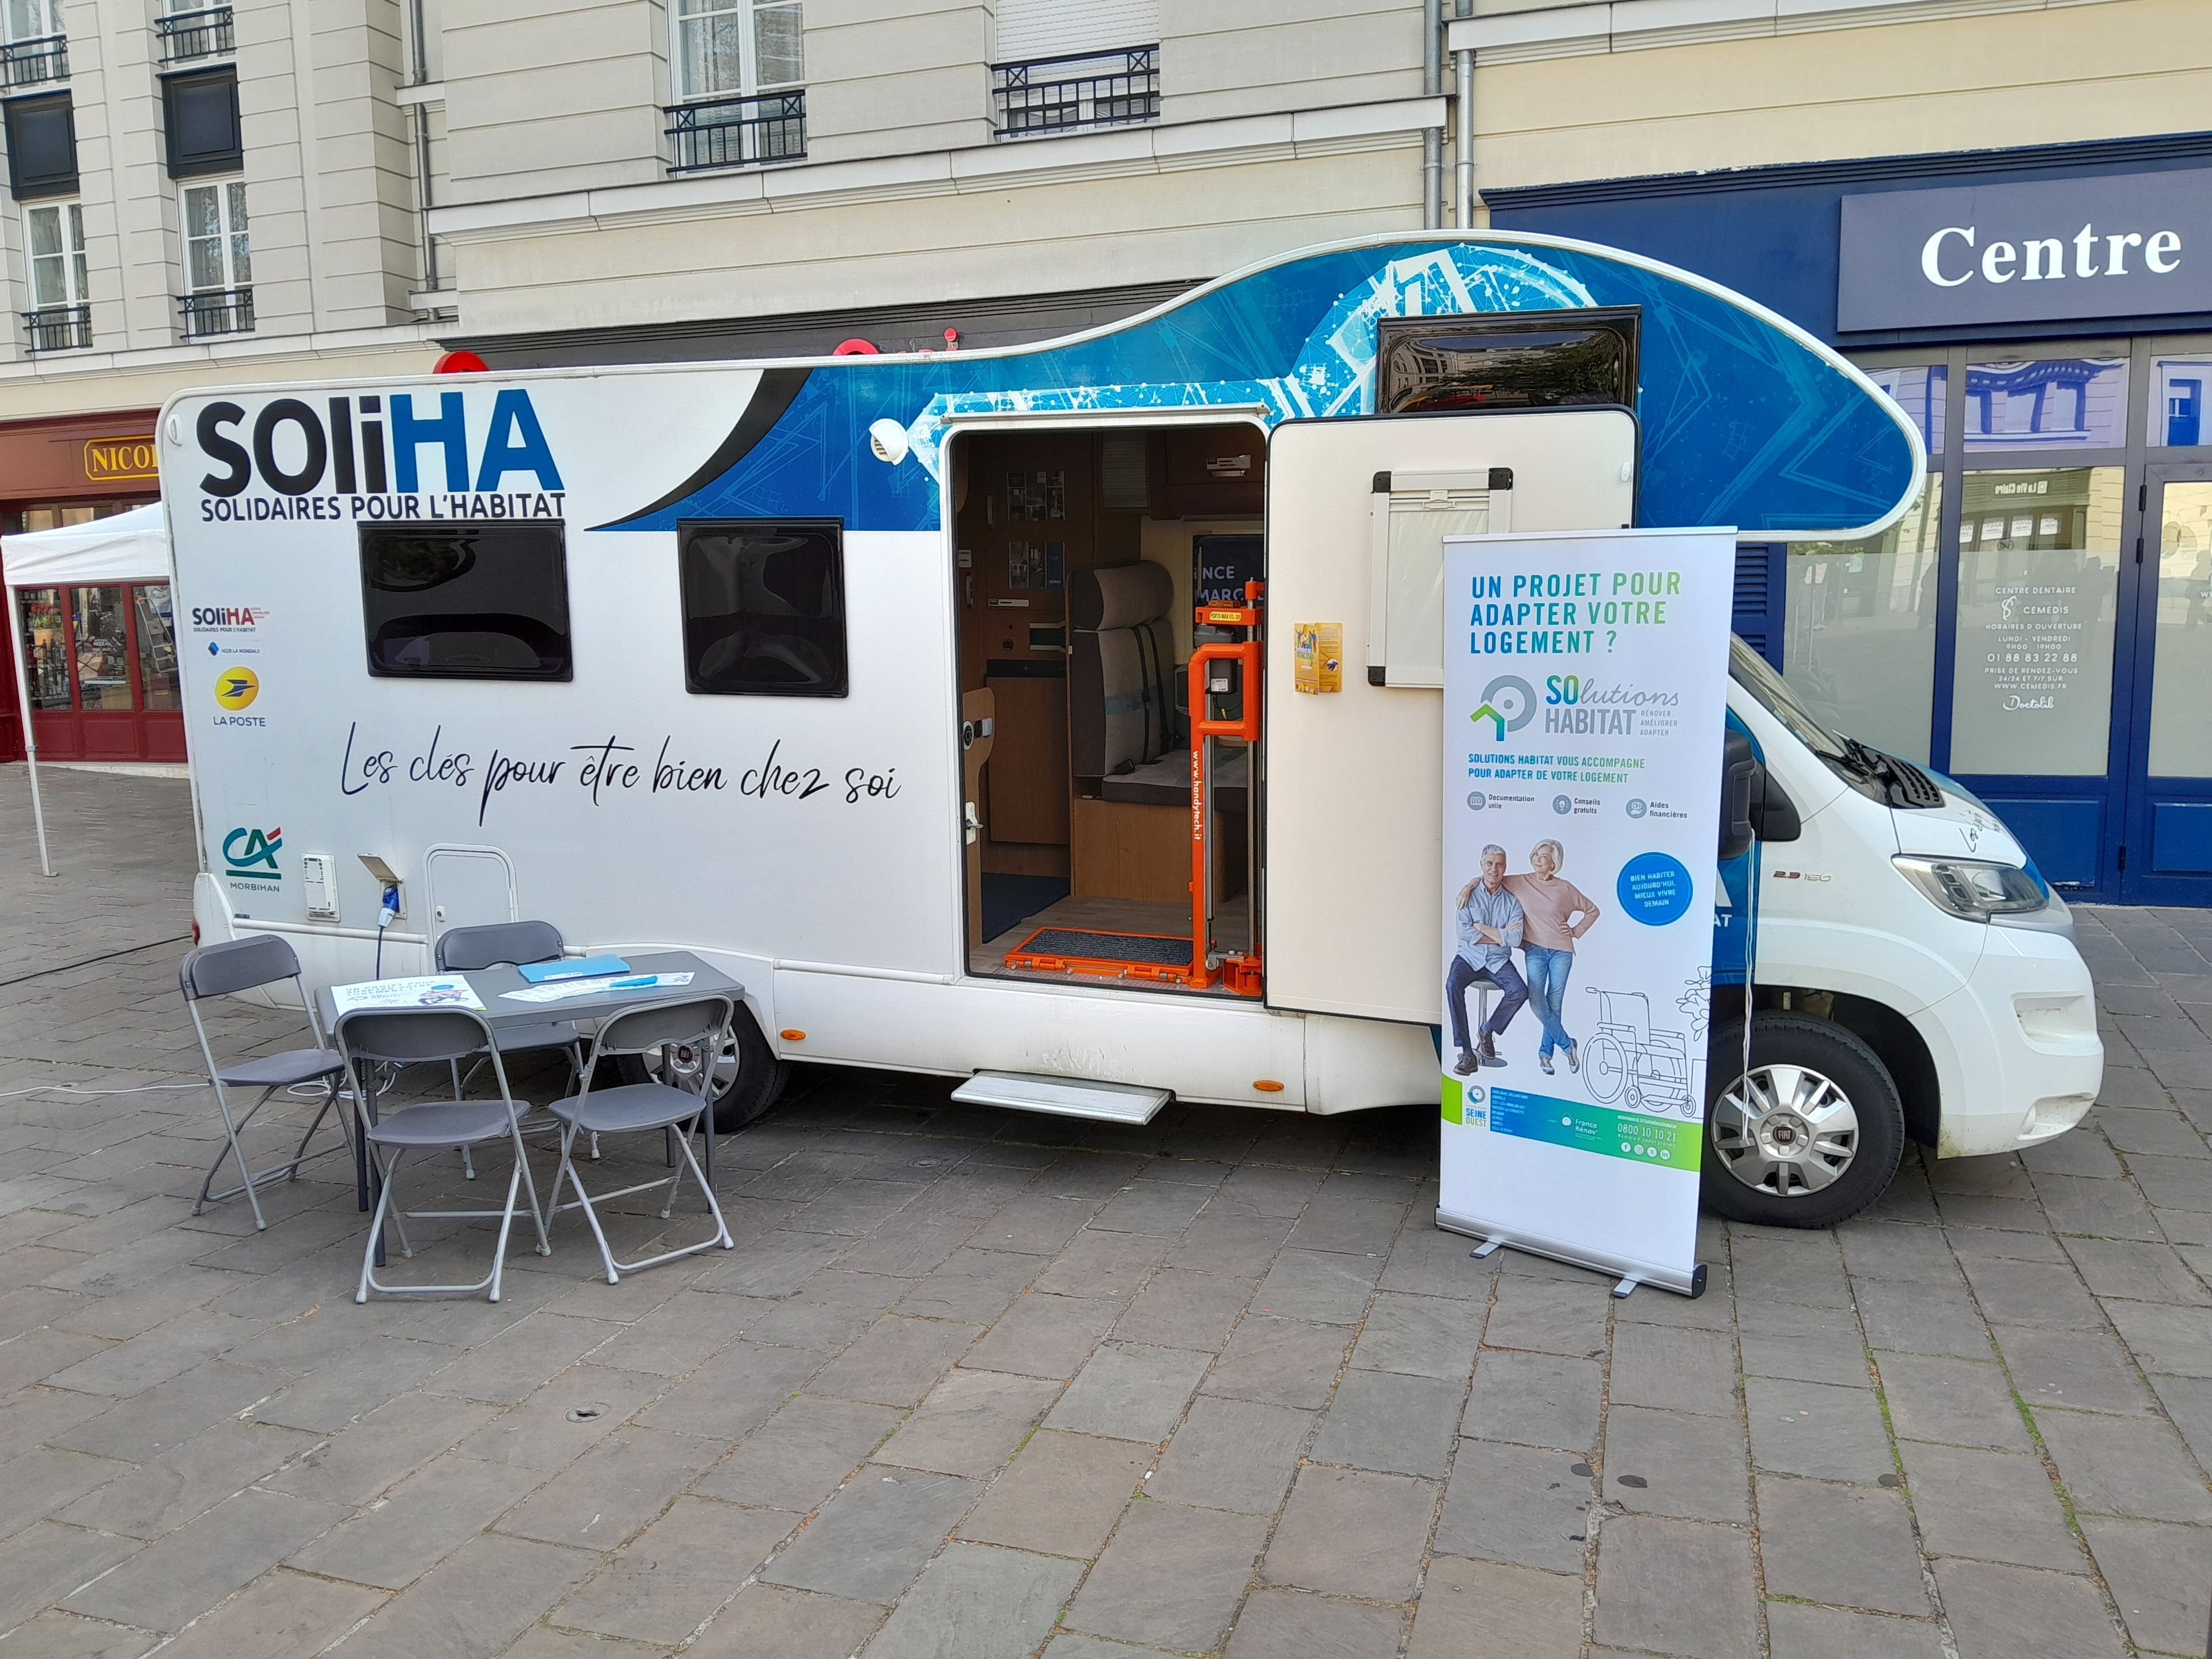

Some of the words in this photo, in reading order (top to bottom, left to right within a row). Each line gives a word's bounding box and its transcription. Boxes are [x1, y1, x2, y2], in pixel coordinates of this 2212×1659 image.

[1922, 223, 2181, 287] Centre
[200, 496, 341, 521] SOLIDAIRES
[352, 495, 421, 519] POUR
[430, 493, 566, 517] L'HABITAT
[1472, 576, 1501, 599] UN
[1513, 573, 1601, 597] PROJET
[1612, 571, 1681, 596] POUR
[1470, 603, 1577, 626] ADAPTER
[1588, 601, 1666, 624] VOTRE
[1471, 630, 1594, 654] LOGEMENT
[1607, 630, 1617, 653] ?
[1987, 653, 2000, 662] 01
[2005, 653, 2020, 662] 88
[2025, 653, 2039, 662] 83
[2044, 653, 2058, 662] 22
[2063, 653, 2077, 662] 88
[2002, 695, 2055, 710] Doctolib
[1641, 709, 1671, 717] RÉNOVER
[213, 716, 228, 725] LA
[229, 717, 266, 726] POSTE
[1545, 709, 1637, 736] HABITAT
[1640, 718, 1678, 727] AMÉLIORER
[1639, 728, 1670, 736] ADAPTER
[1468, 753, 1515, 764] SOLUTIONS
[1518, 755, 1554, 765] HABITAT
[1557, 756, 1579, 766] VOUS
[1582, 757, 1646, 768] ACCOMPAGNE
[341, 721, 397, 794] Les
[479, 749, 569, 826] pour
[570, 736, 641, 806] être
[652, 736, 728, 793] bien
[740, 740, 830, 800] chez
[844, 767, 903, 804] soi
[1468, 768, 1491, 778] POUR
[1494, 769, 1533, 779] ADAPTER
[1536, 770, 1548, 780] DE
[1551, 771, 1577, 781] VOTRE
[1580, 772, 1629, 783] LOGEMENT
[1192, 751, 1202, 840] www.handytech.it
[1488, 793, 1535, 802] Documentation
[1574, 806, 1597, 815] gratuits
[1650, 809, 1688, 819] financières
[1647, 871, 1675, 880] HABITER
[230, 882, 280, 892] MORBIHAN
[1634, 891, 1656, 899] MIEUX
[1657, 889, 1676, 897] VIVRE
[1644, 899, 1669, 908] DEMAIN
[1466, 1108, 1487, 1119] SEINE
[1466, 1116, 1487, 1127] OUEST
[1575, 1119, 1597, 1128] France
[1618, 1123, 1638, 1135] 0800
[1642, 1127, 1651, 1137] 10
[1655, 1130, 1664, 1139] 10
[1666, 1131, 1676, 1142] 21
[1778, 1130, 1791, 1139] FIAT
